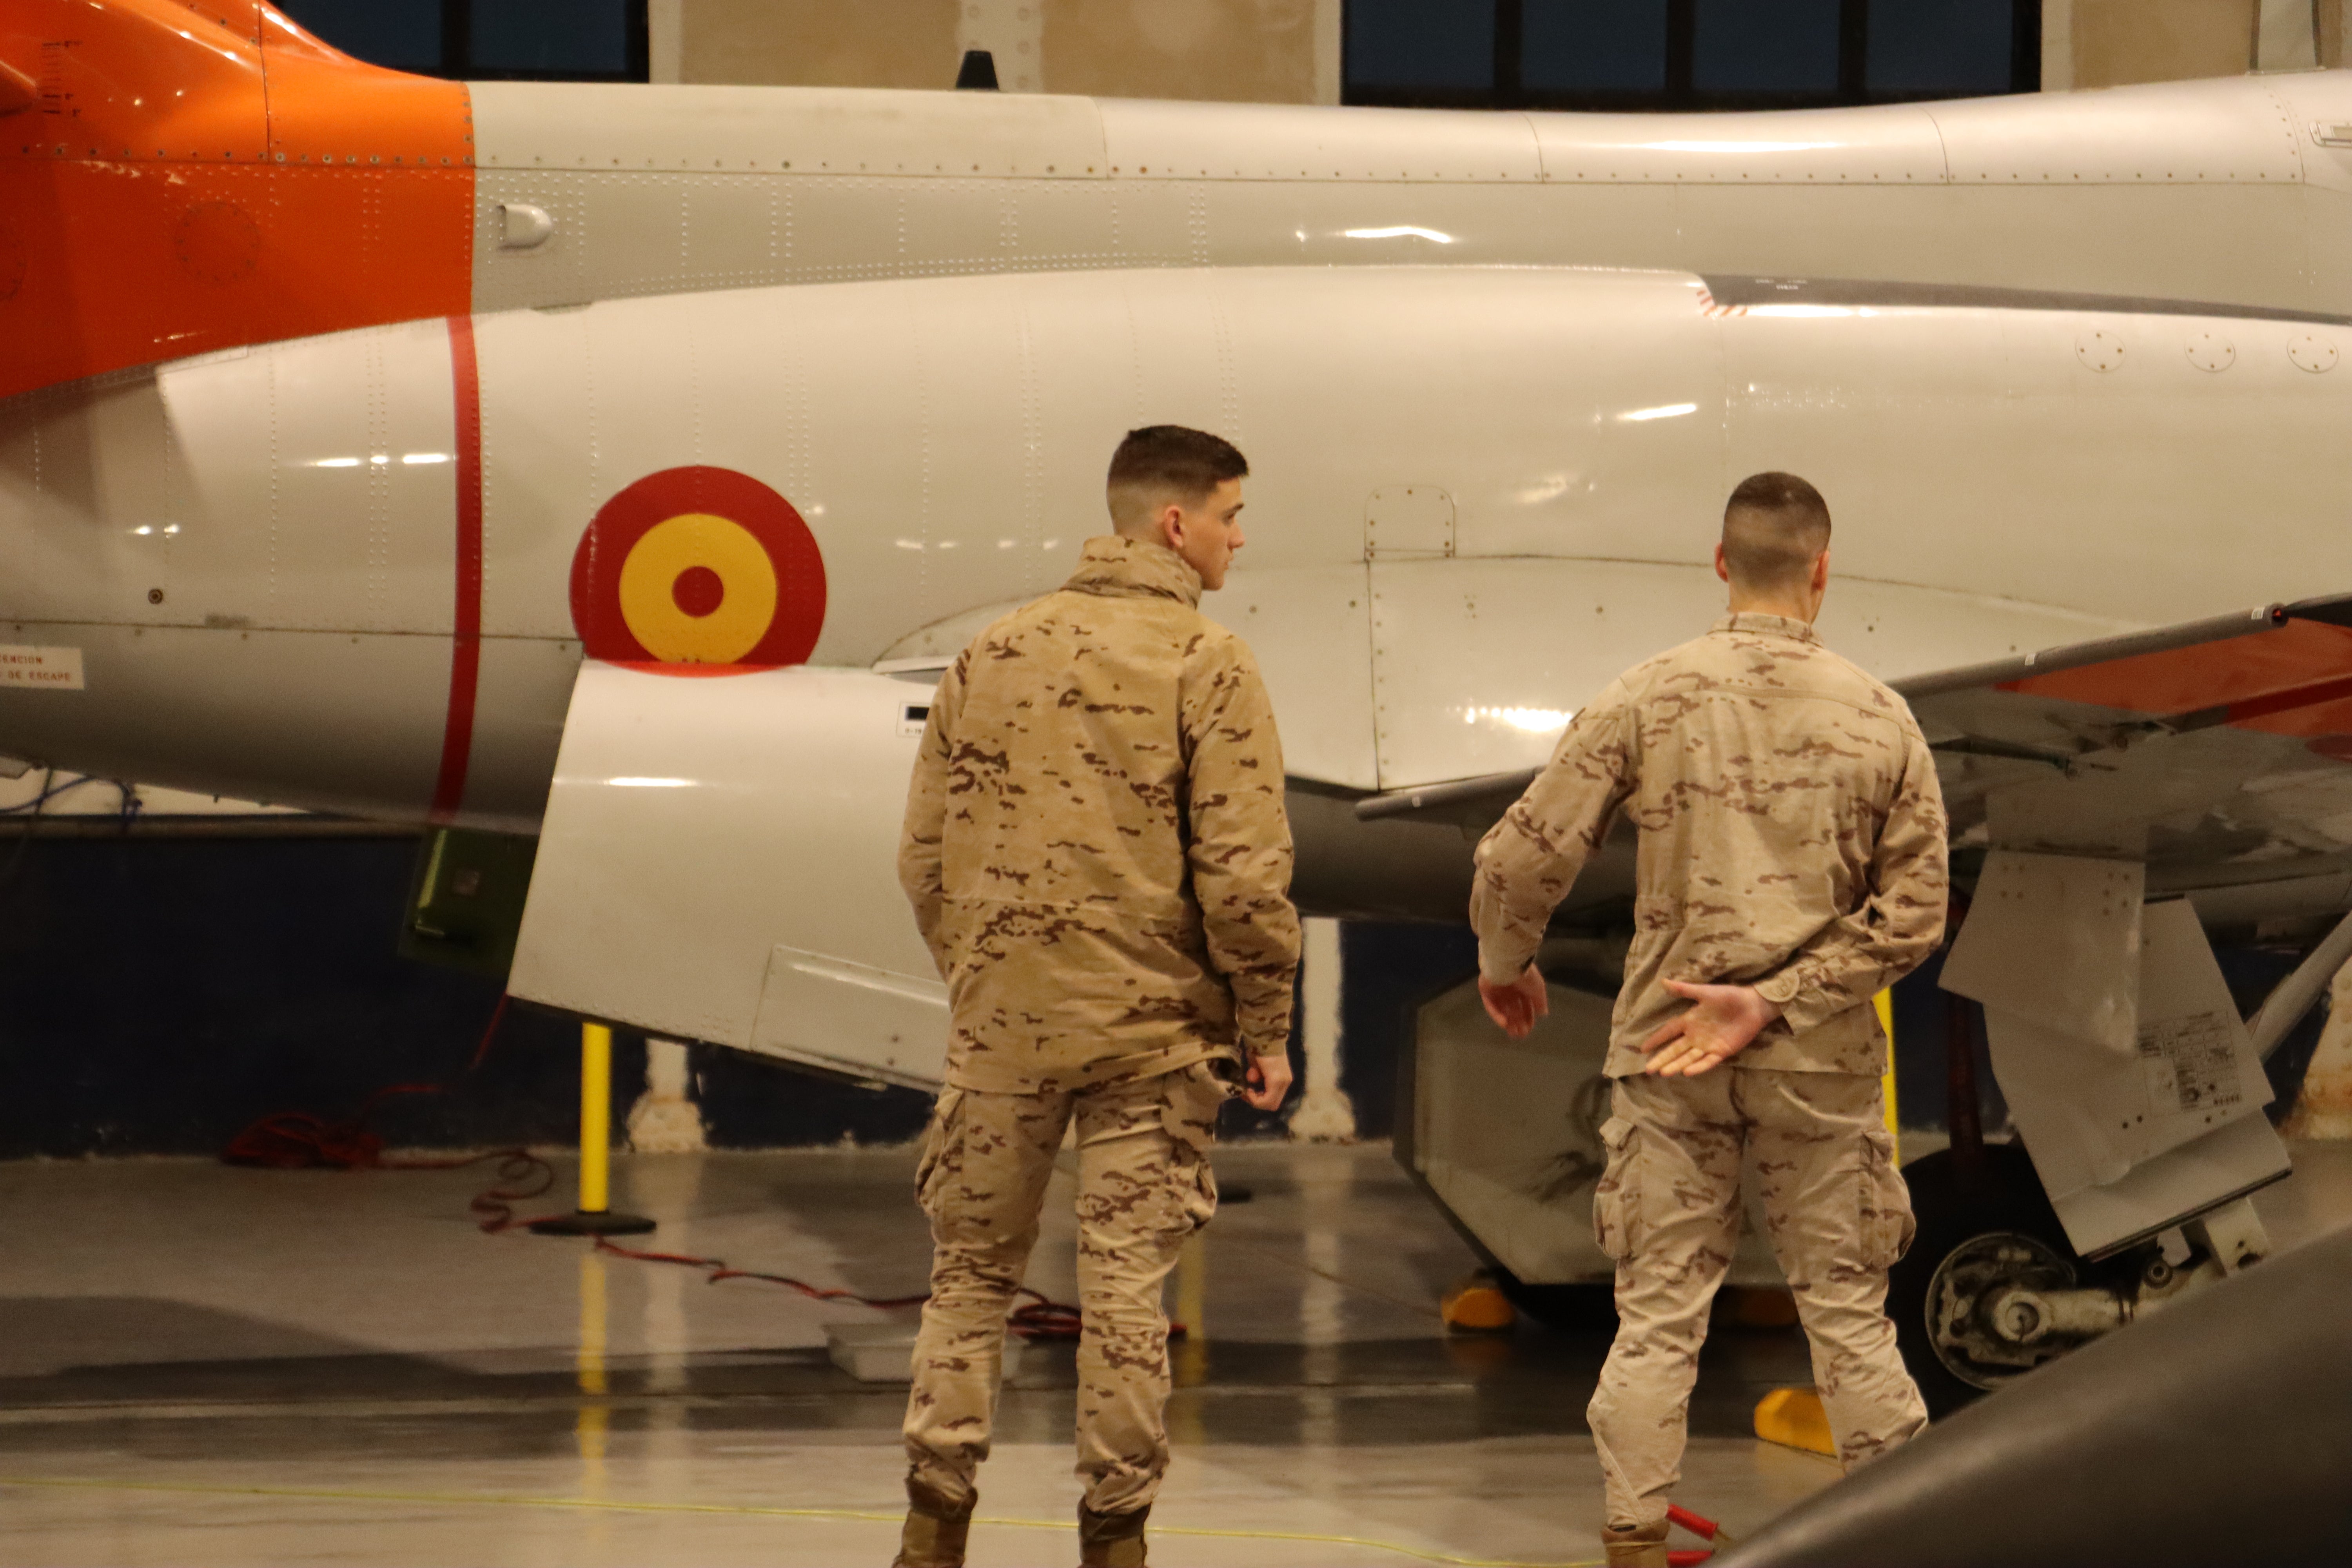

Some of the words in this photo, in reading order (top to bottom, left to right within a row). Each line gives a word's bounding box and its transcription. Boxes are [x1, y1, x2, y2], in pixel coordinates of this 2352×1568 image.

[0, 654, 42, 664] ENCION
[8, 670, 21, 679] DE
[29, 671, 70, 681] ESCAPE
